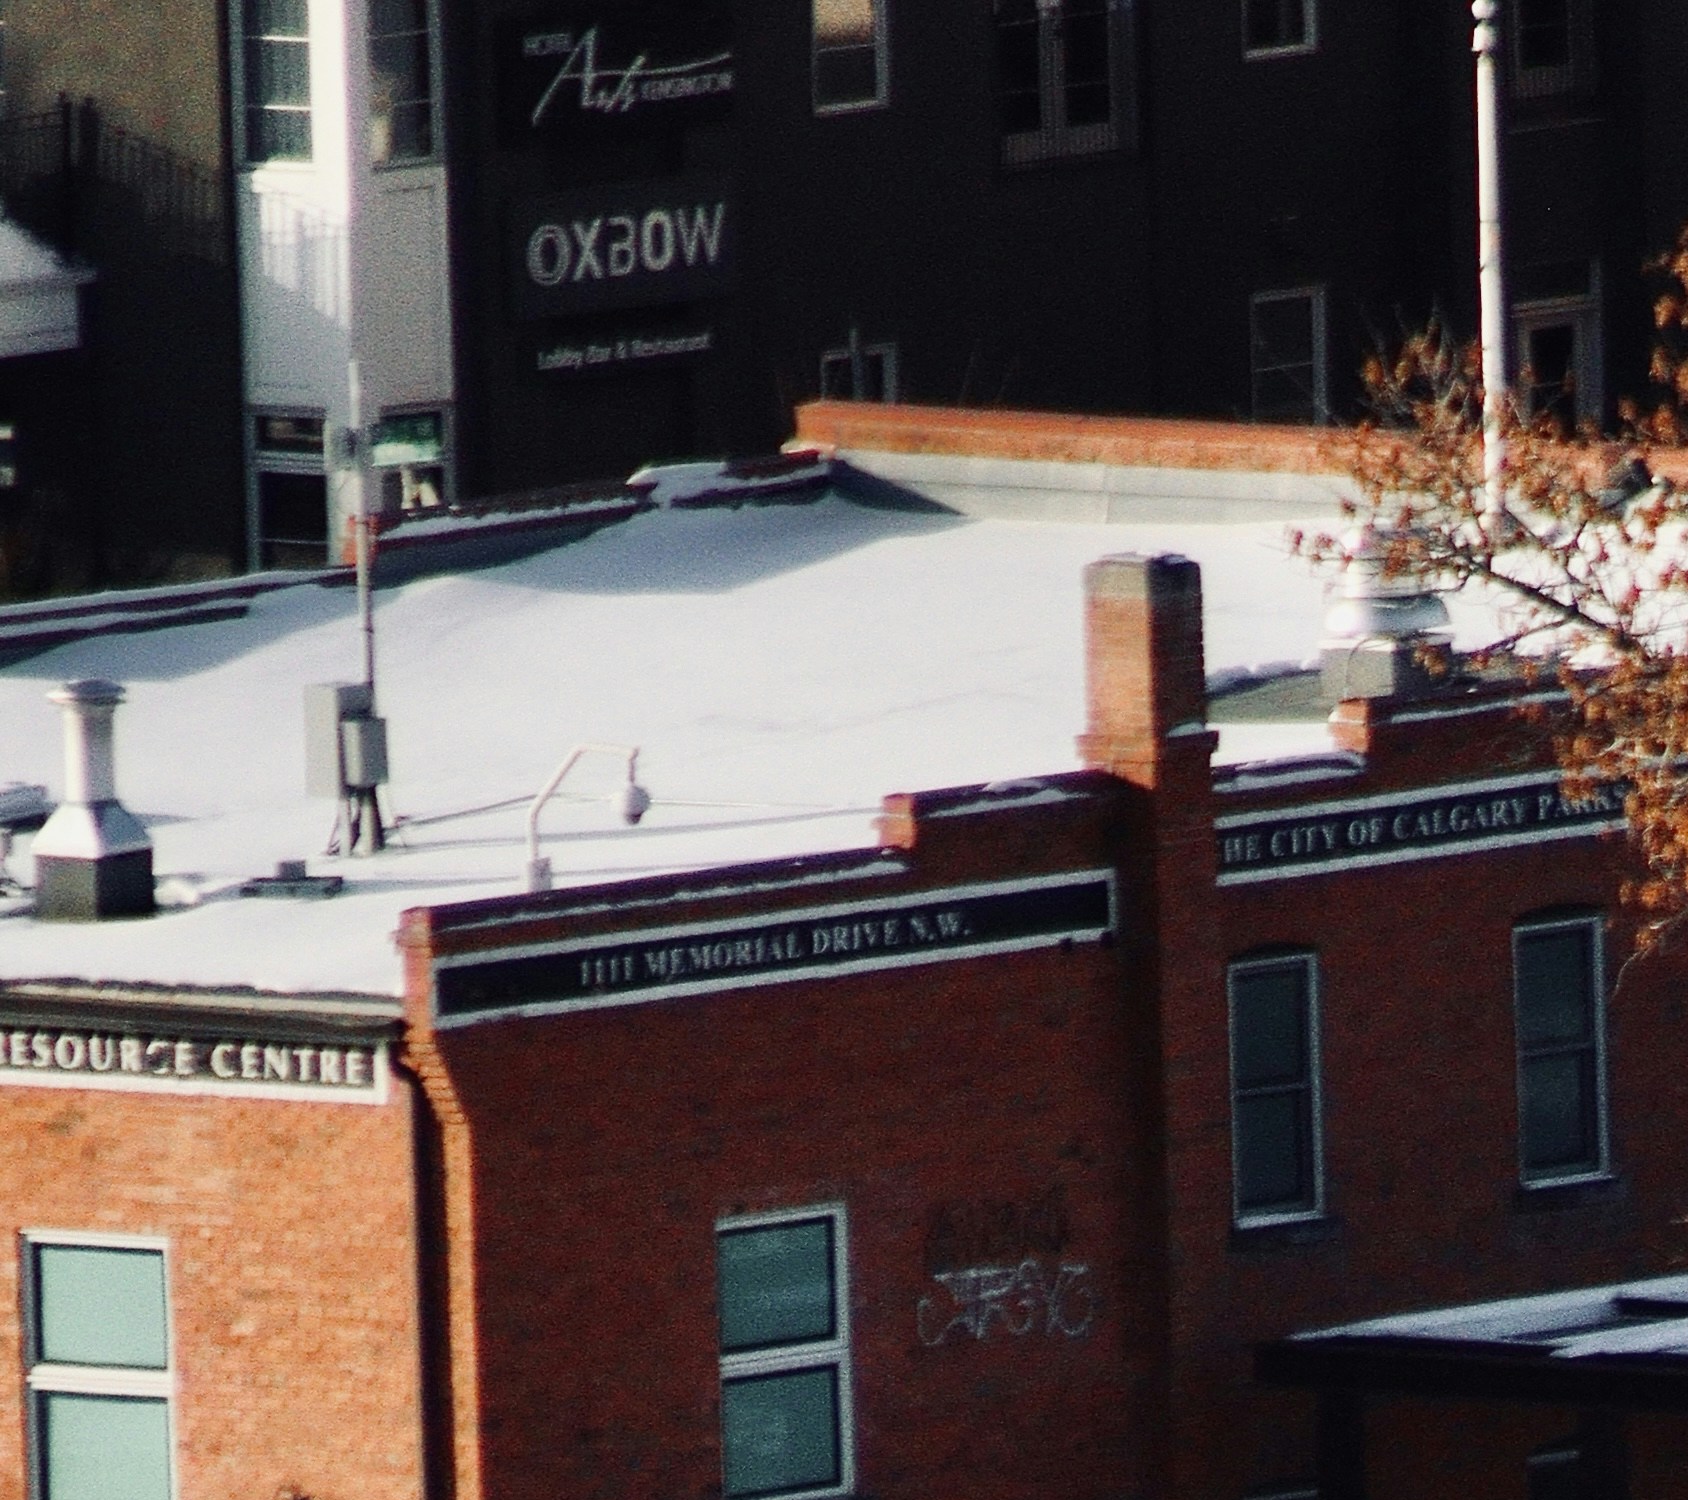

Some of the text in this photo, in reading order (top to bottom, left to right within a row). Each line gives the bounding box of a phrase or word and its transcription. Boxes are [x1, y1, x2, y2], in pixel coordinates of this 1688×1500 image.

[525, 203, 724, 287] OXBOW
[1217, 835, 1261, 864] HE
[1271, 822, 1338, 858] CITY
[1348, 817, 1383, 846] OF
[1392, 798, 1528, 840] CALGARY
[643, 928, 803, 980] MEMORIAL
[811, 918, 902, 956] DRIVE
[908, 911, 973, 943] N.W.
[210, 1043, 366, 1085] CENTRE
